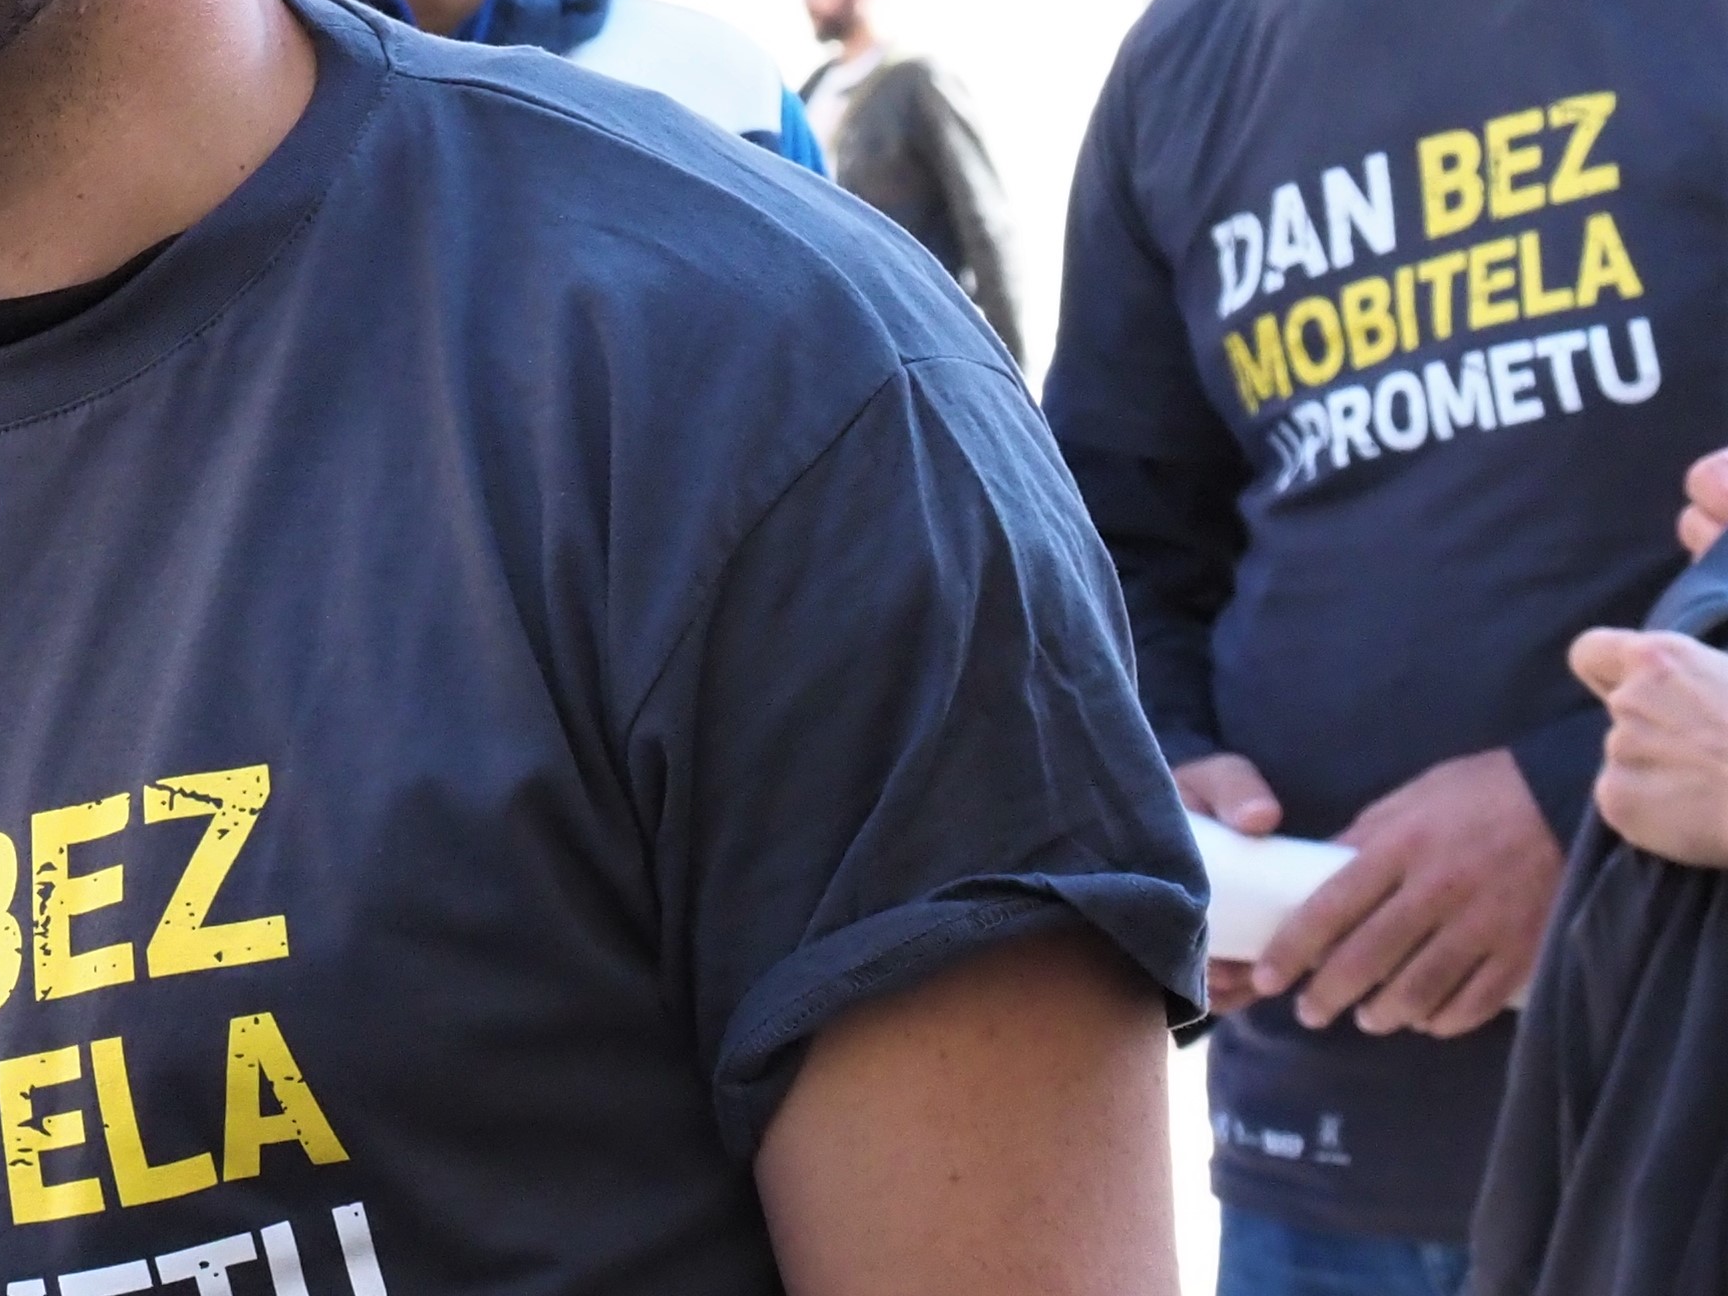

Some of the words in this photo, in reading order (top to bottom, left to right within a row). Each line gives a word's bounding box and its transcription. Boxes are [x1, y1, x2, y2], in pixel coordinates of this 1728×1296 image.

[1210, 151, 1397, 319] DAN
[1416, 90, 1621, 240] BEZ
[1223, 210, 1645, 417] MOBITELA
